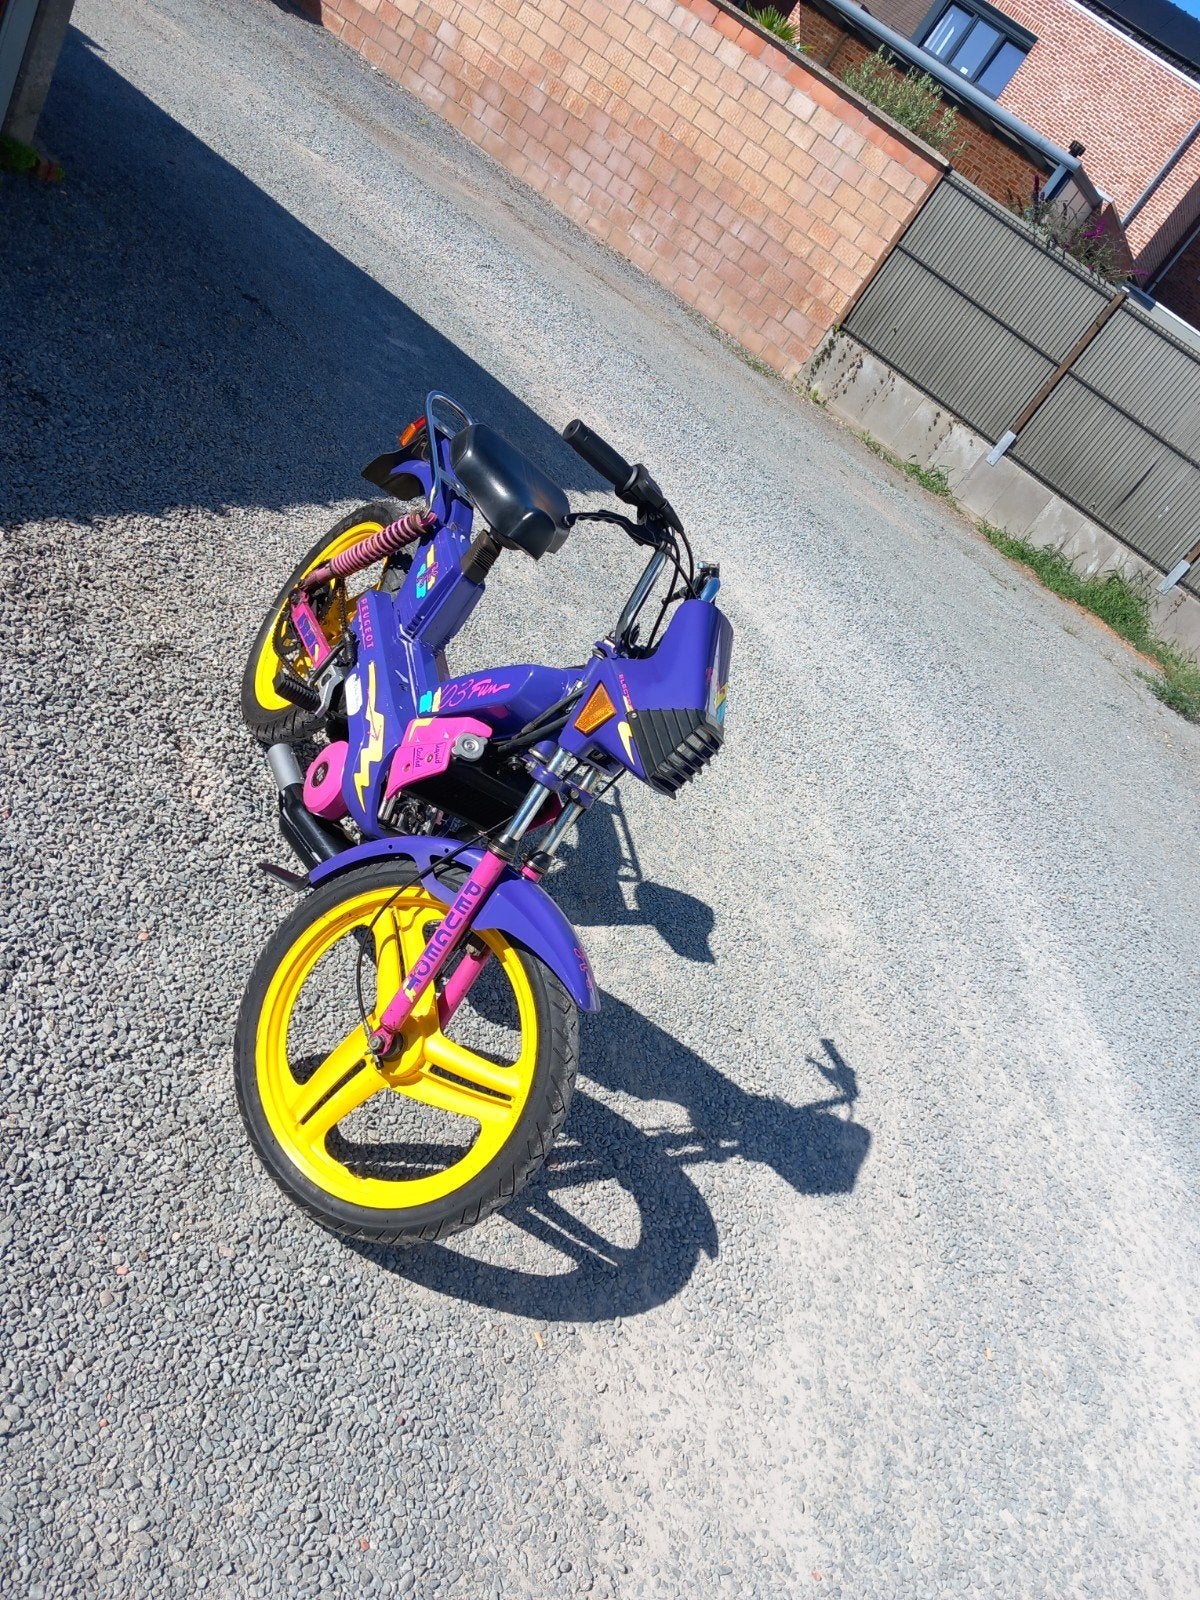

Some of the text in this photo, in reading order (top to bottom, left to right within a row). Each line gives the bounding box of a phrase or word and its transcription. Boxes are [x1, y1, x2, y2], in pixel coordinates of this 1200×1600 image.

[360, 597, 375, 649] PEUGEOT
[468, 678, 511, 700] Fun
[406, 880, 482, 991] PEUGEOT
